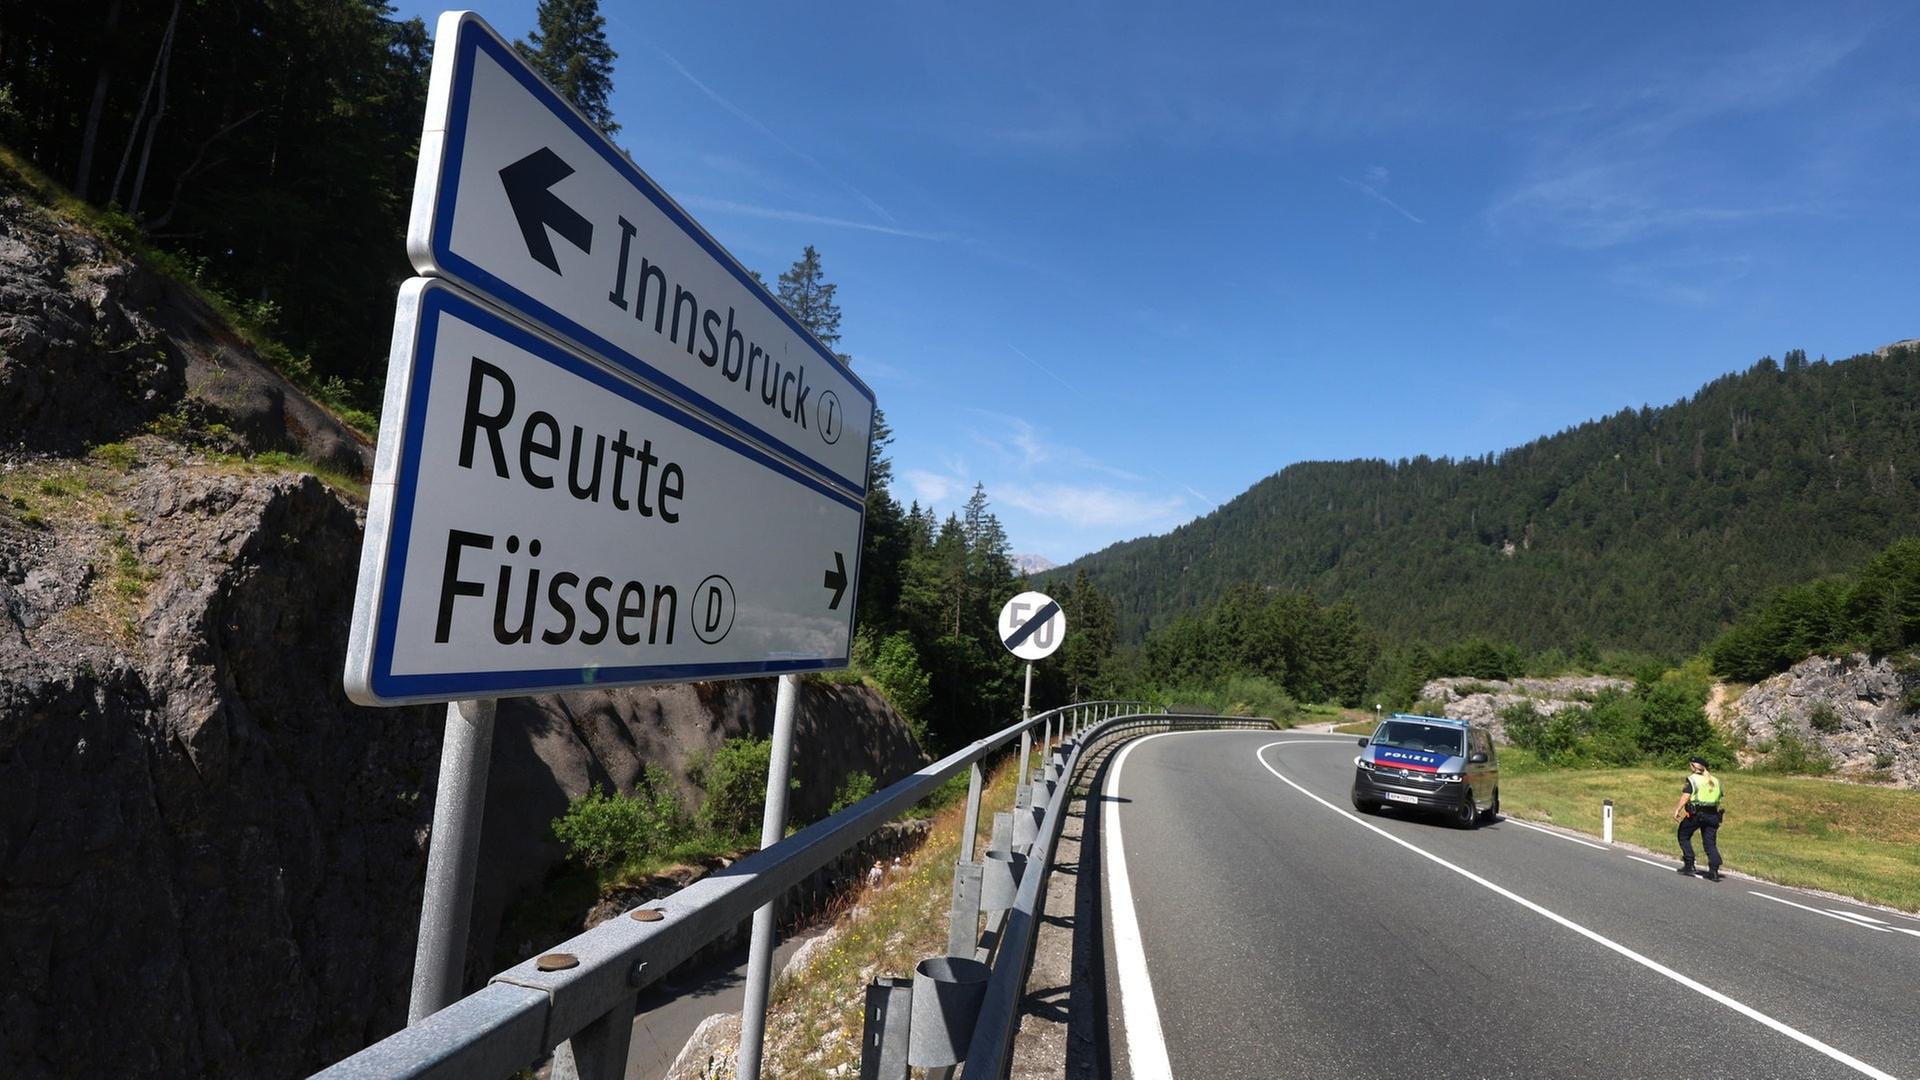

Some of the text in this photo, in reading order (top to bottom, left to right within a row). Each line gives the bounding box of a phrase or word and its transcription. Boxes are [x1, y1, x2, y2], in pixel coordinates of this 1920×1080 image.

[608, 214, 835, 436] Innsbruck I
[458, 356, 685, 524] Reutte
[434, 529, 723, 646] Füssen D
[1384, 752, 1435, 763] POLIZEI
